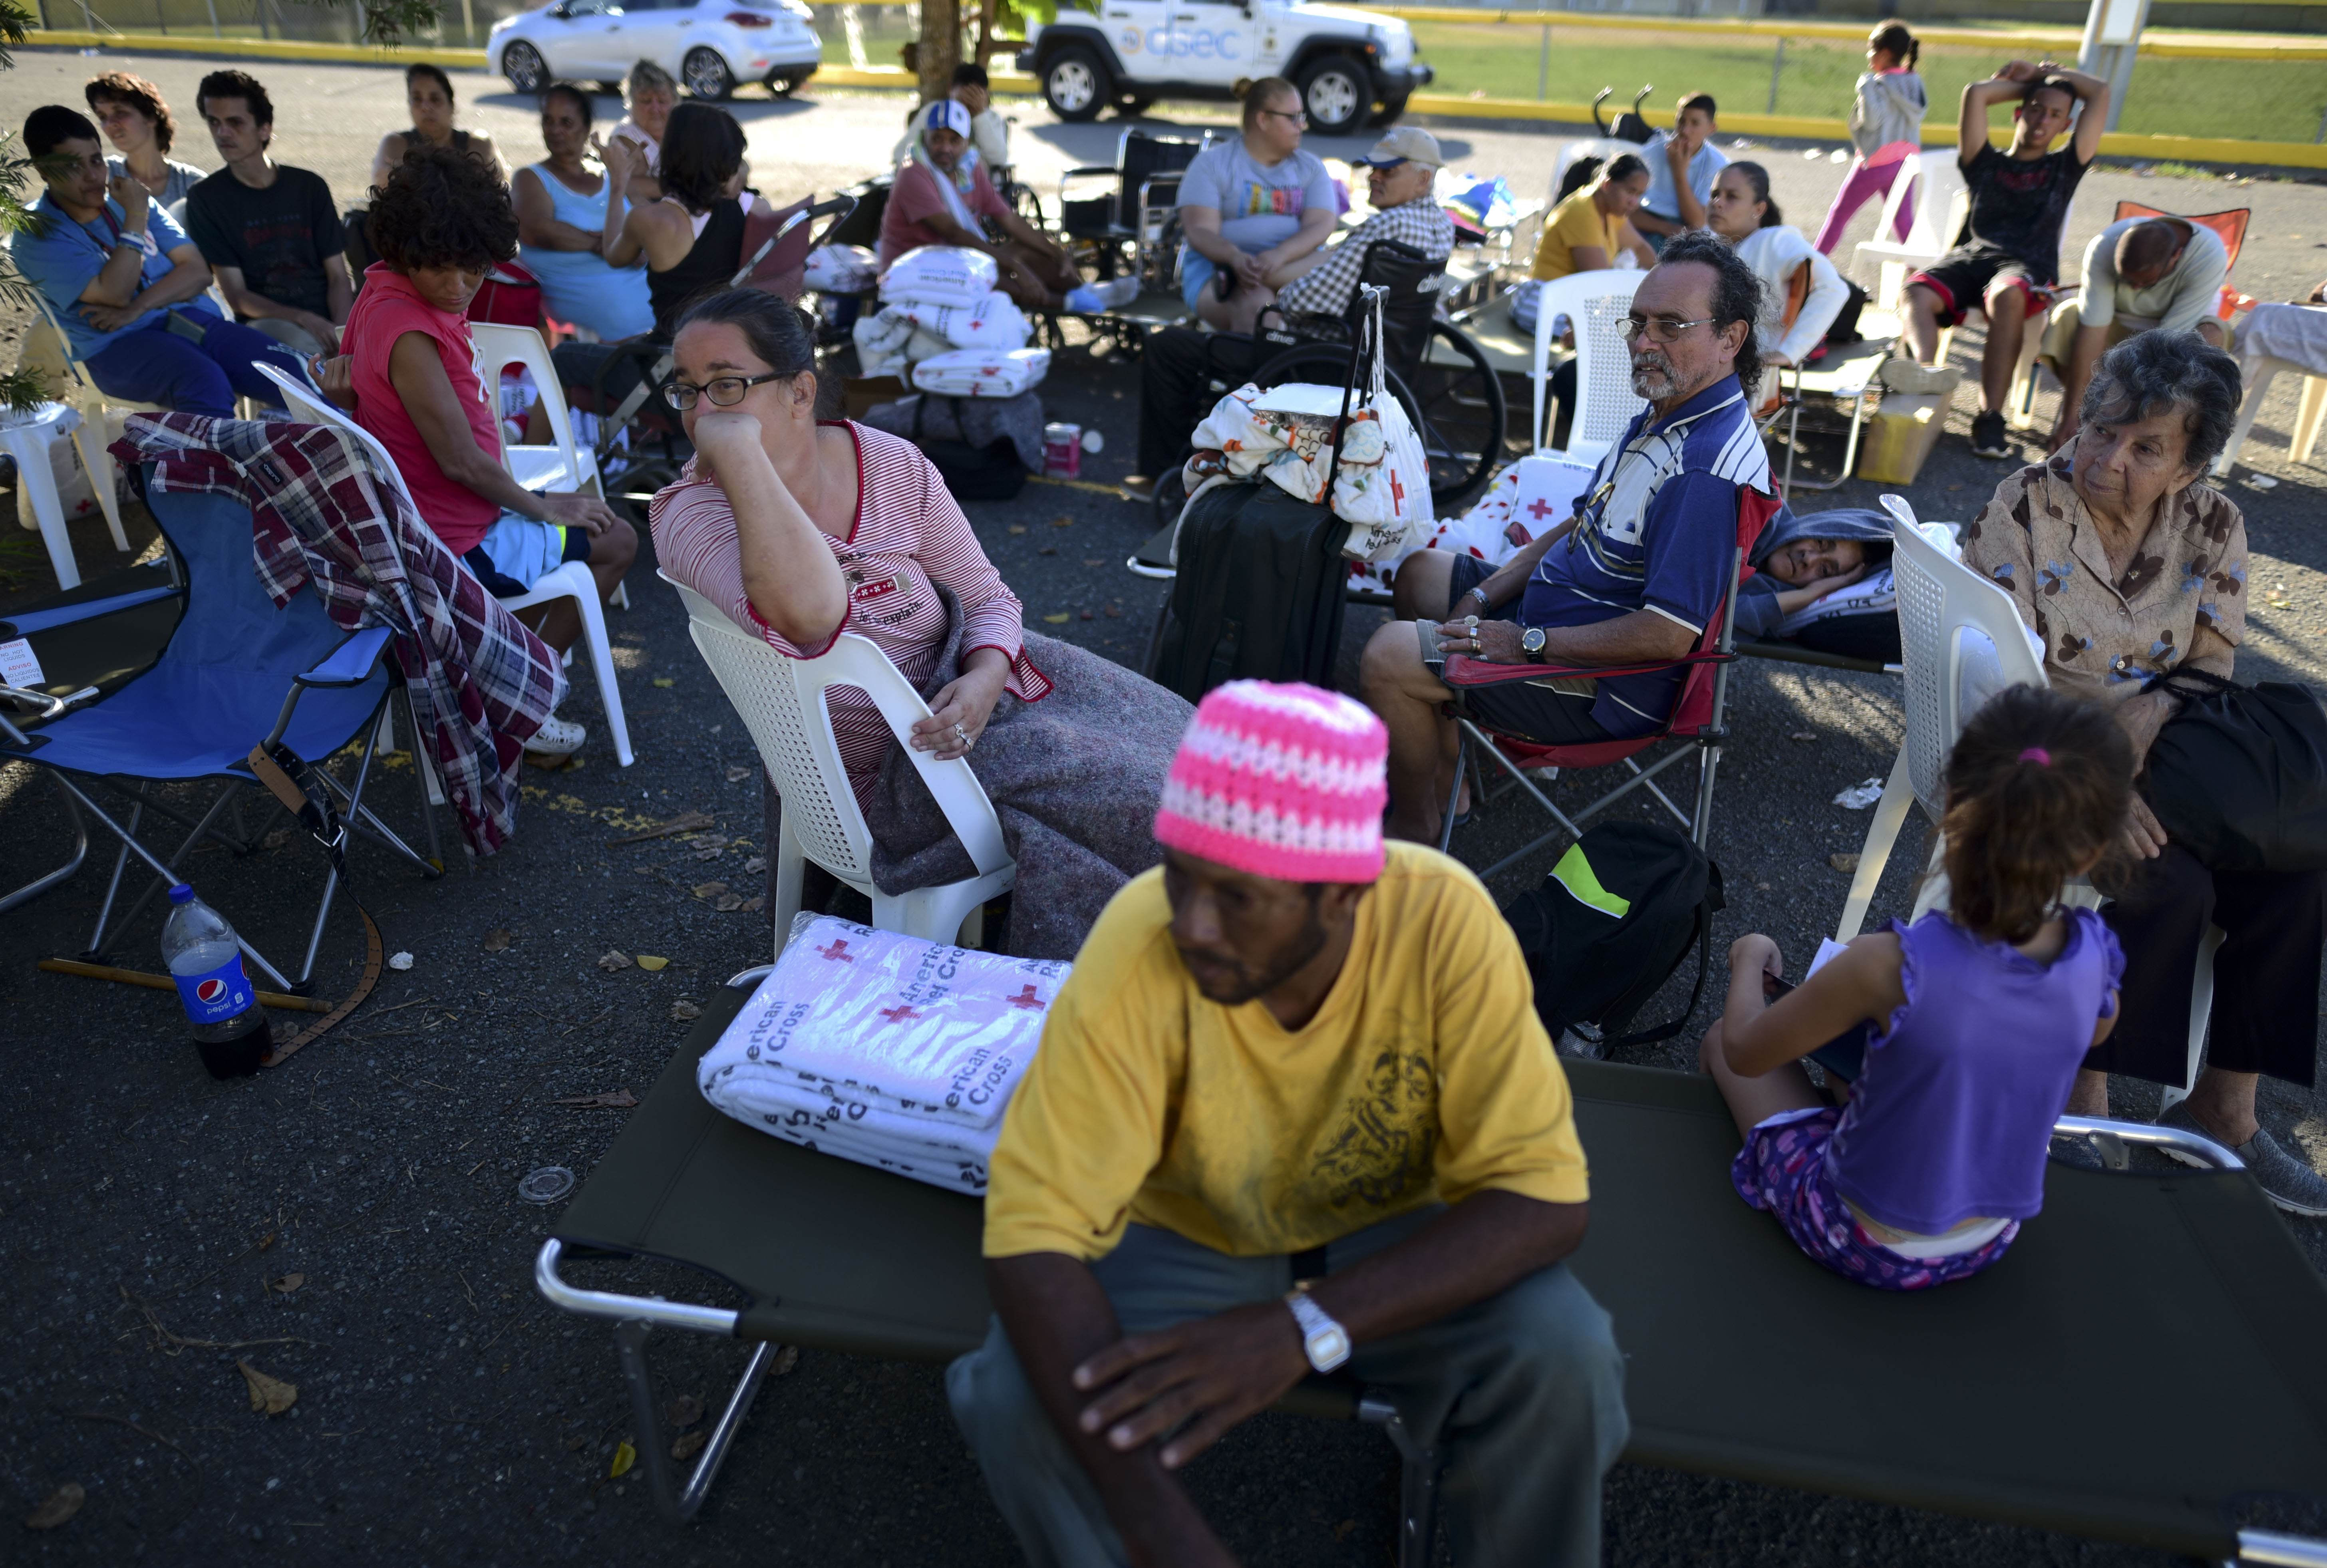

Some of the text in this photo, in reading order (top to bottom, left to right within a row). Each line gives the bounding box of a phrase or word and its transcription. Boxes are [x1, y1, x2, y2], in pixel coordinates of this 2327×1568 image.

[0, 642, 24, 650] ARNING
[8, 663, 32, 671] ADVISO
[14, 668, 40, 676] LIQUIDOS
[10, 673, 40, 683] CALIENTES
[207, 1001, 231, 1015] pepsi
[747, 1001, 787, 1061] erican
[767, 1003, 810, 1052] Cross
[945, 1048, 990, 1108] erican
[968, 1055, 1012, 1105] Cross
